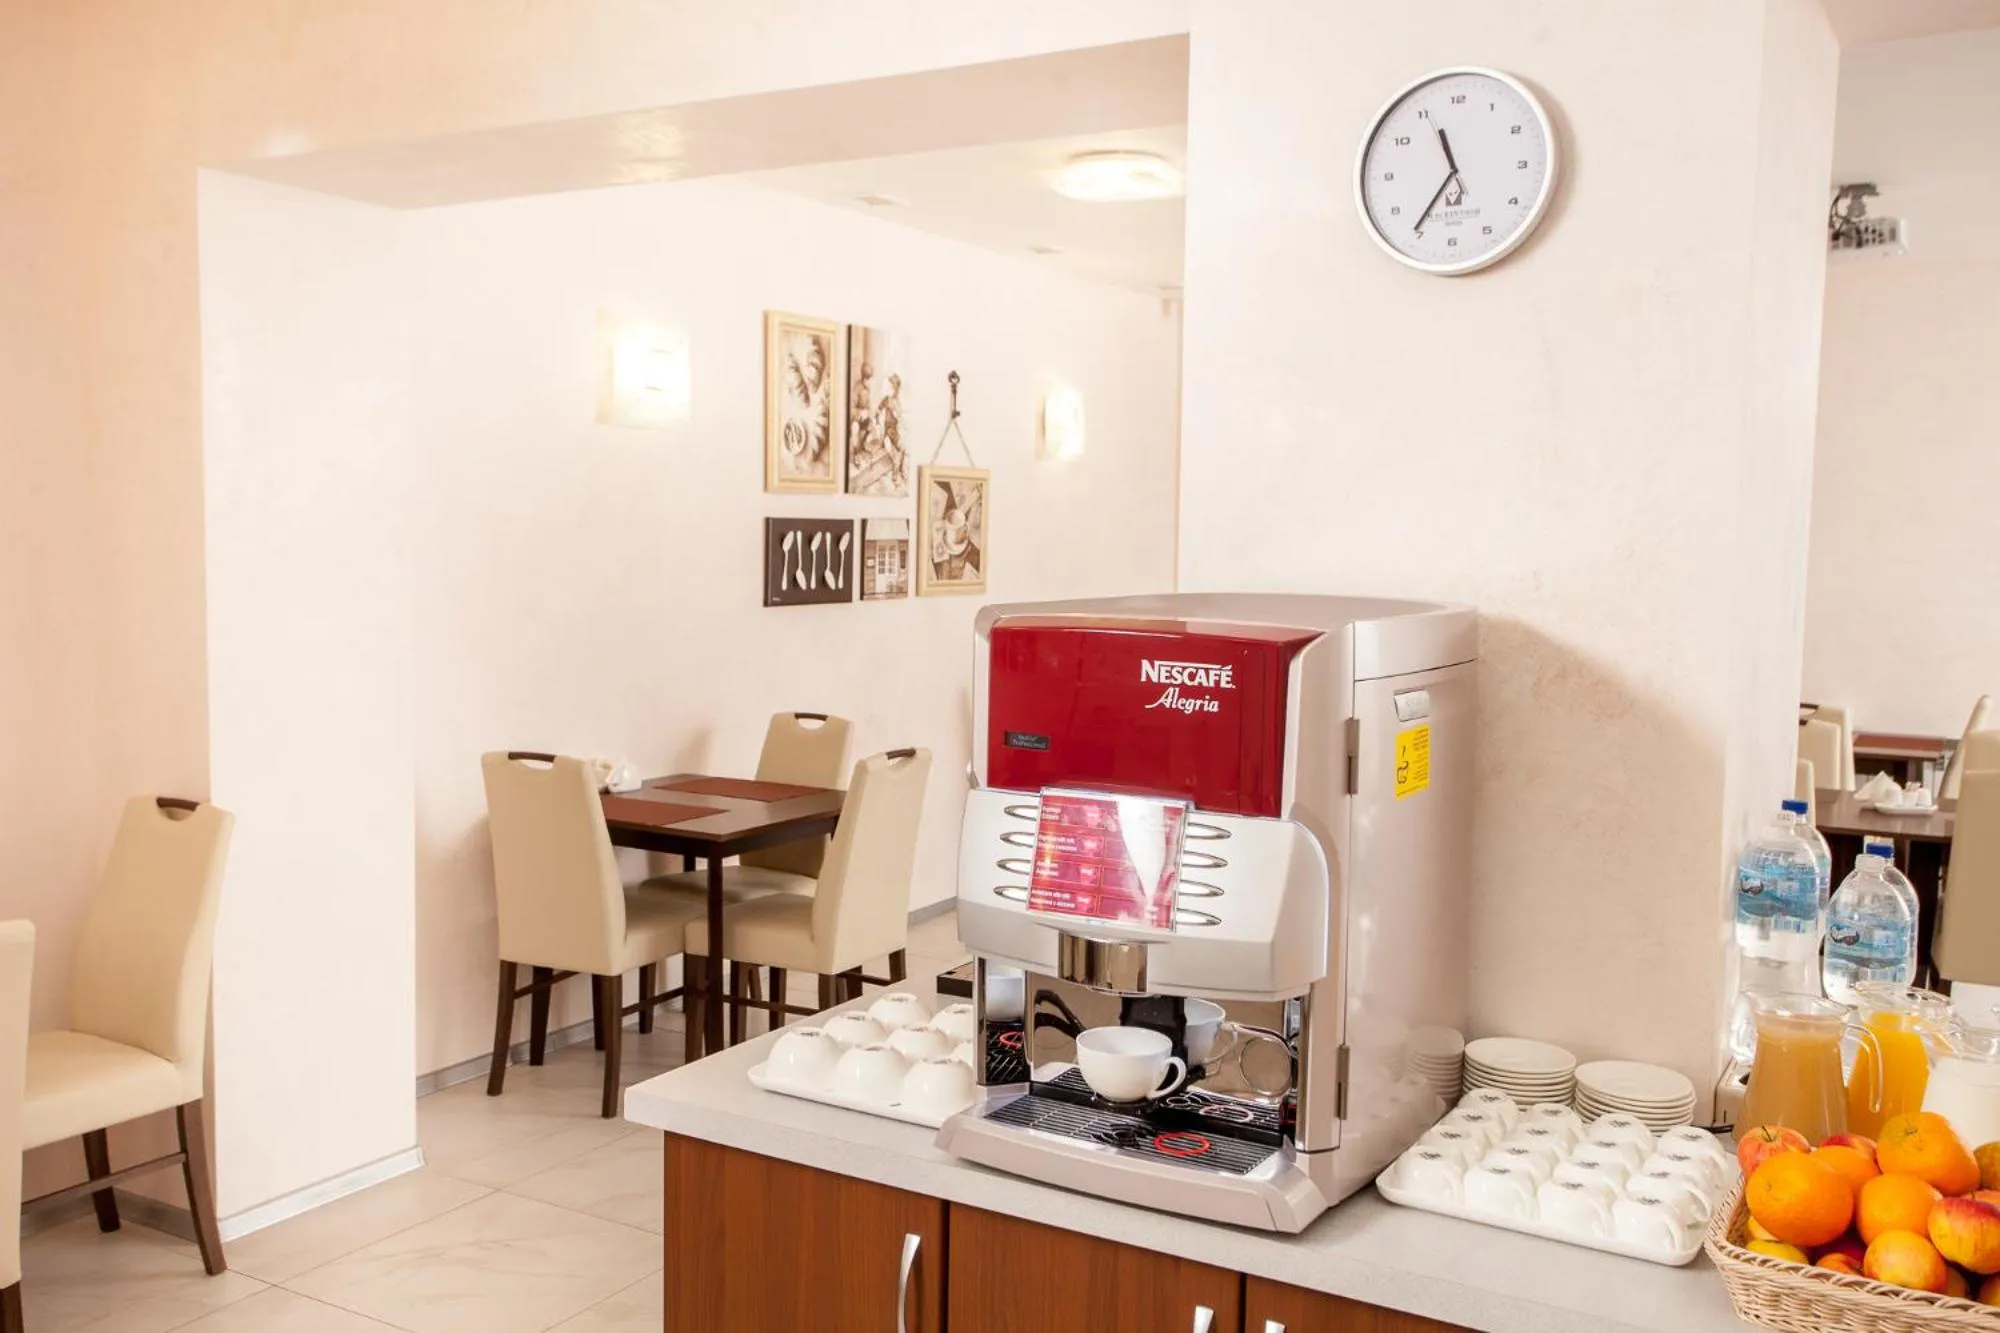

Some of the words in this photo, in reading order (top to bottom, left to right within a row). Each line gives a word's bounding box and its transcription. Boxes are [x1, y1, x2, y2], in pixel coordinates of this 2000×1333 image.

[1451, 95, 1466, 104] 12
[1489, 103, 1494, 112] 1
[1511, 125, 1521, 134] 2
[1394, 137, 1410, 146] 10
[1517, 160, 1528, 169] 3
[1384, 172, 1394, 181] 9
[1508, 197, 1518, 205] 4
[1391, 206, 1400, 215] 8
[1482, 226, 1493, 235] 5
[1416, 231, 1424, 240] 7
[1447, 238, 1457, 246] 6
[1144, 686, 1220, 714] Alegria
